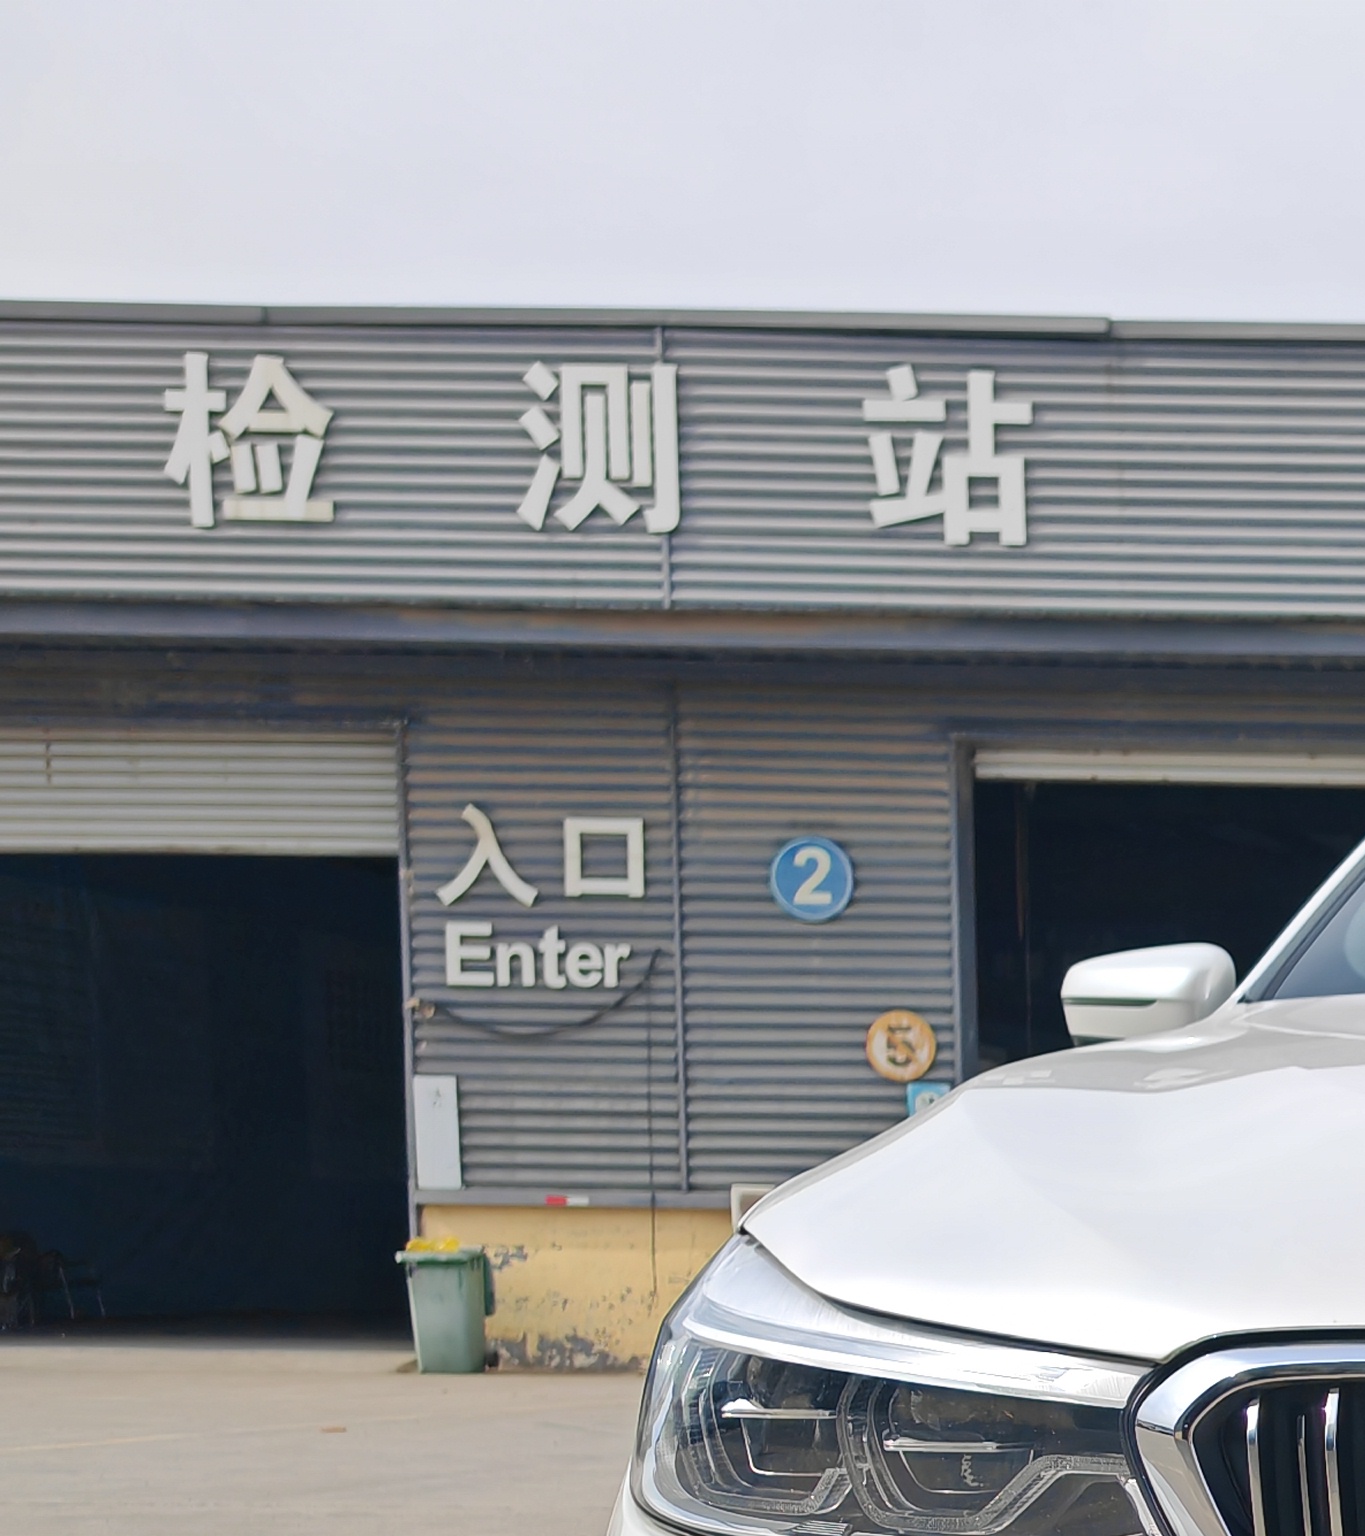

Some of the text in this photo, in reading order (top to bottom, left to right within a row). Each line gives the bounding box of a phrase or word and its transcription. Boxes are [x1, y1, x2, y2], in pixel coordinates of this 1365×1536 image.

[164, 351, 1033, 547] 检测站
[435, 803, 645, 907] 入口
[793, 846, 832, 906] 2
[445, 921, 631, 989] Enter
